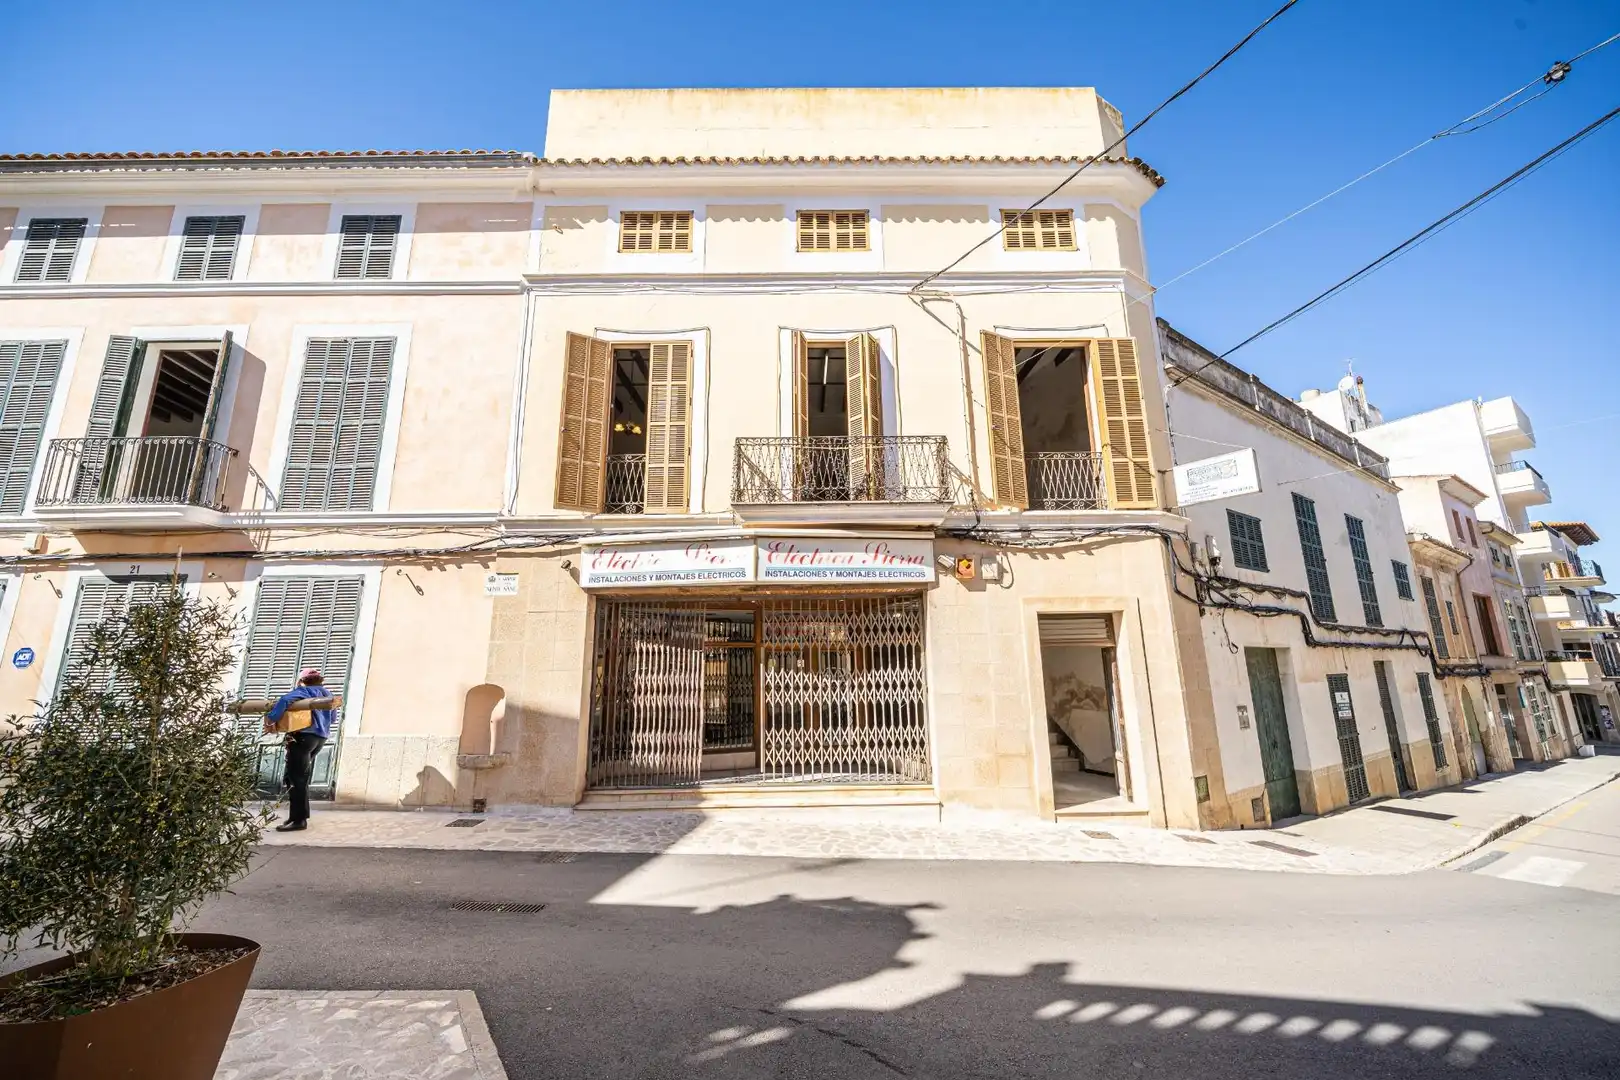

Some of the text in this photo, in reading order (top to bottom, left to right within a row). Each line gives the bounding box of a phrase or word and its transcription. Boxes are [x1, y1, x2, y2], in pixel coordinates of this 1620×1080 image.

[130, 564, 141, 574] 21
[765, 570, 828, 578] INSTALACIONES
[836, 570, 877, 578] MONTAJES
[588, 575, 647, 584] INSTALACIONES
[655, 573, 696, 582] MONTAJES
[697, 571, 747, 580] ELECTRICOS
